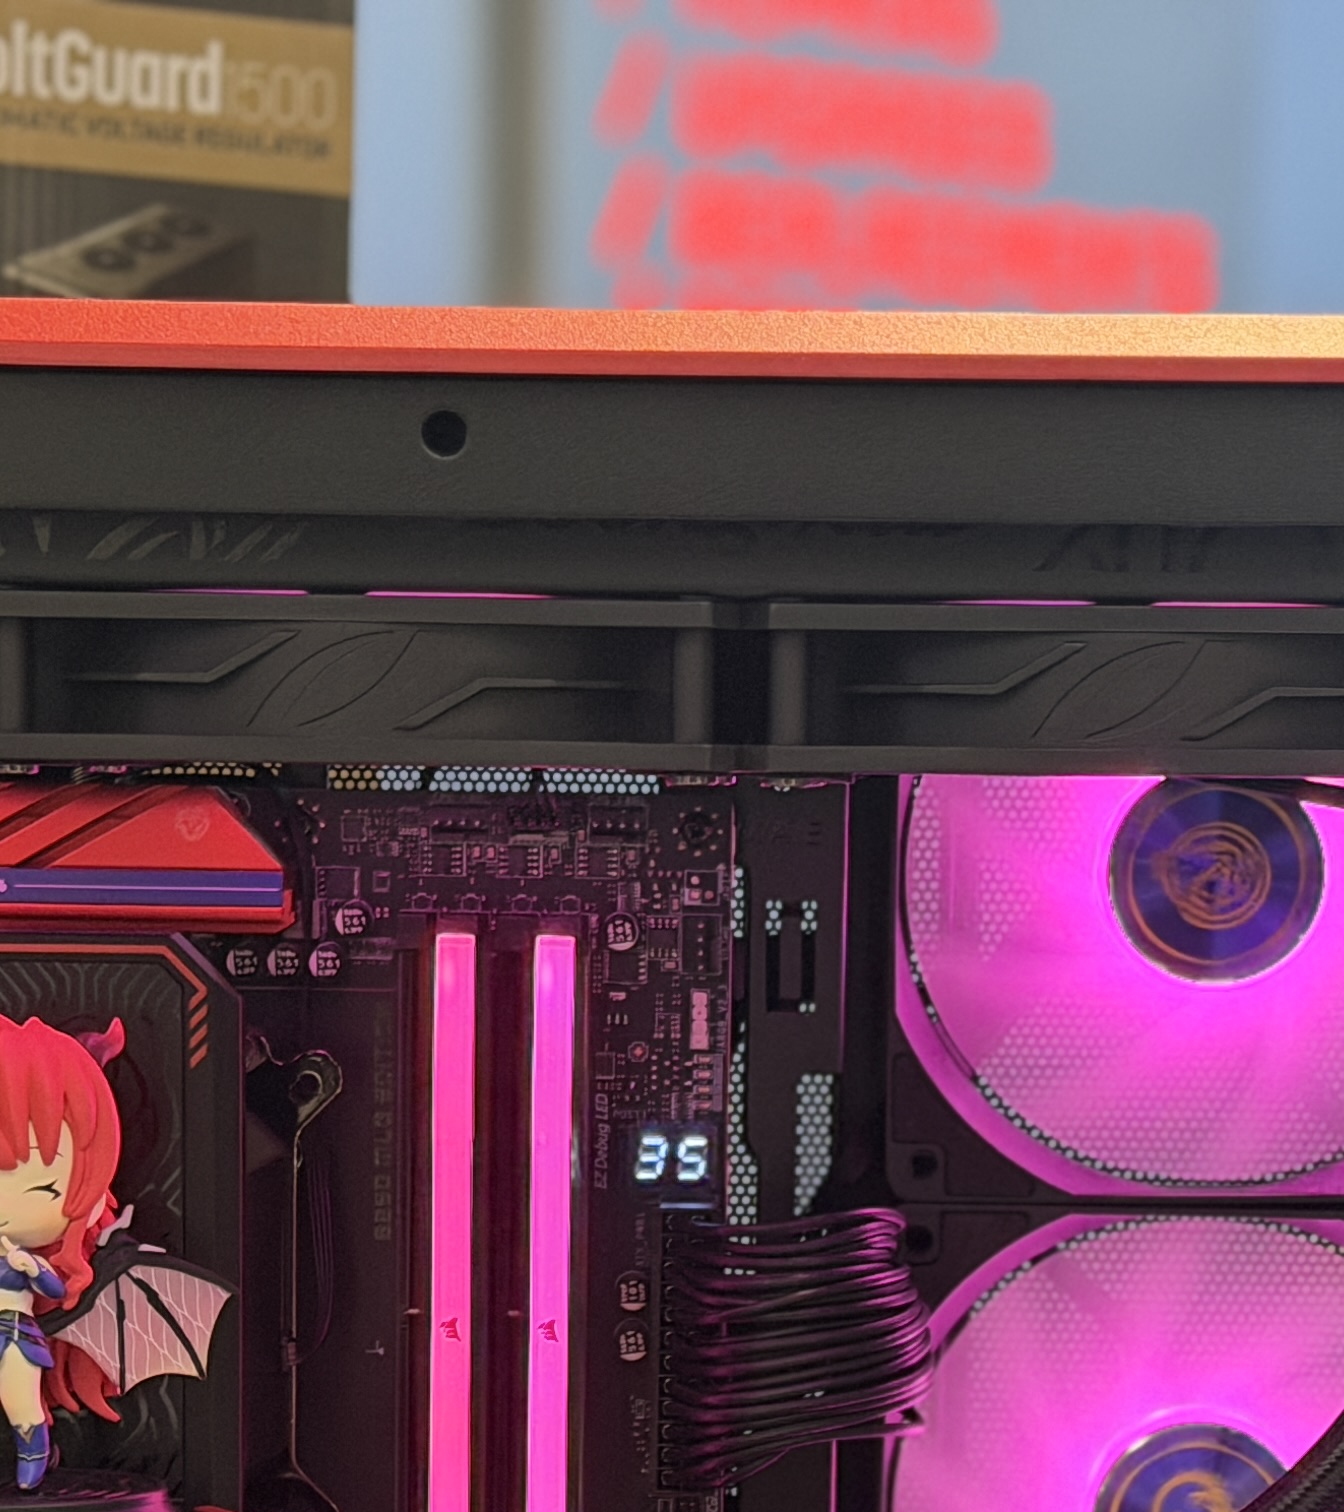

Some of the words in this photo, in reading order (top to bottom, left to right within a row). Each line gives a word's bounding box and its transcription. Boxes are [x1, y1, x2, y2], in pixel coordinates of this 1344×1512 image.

[595, 1093, 607, 1120] LED
[594, 1123, 611, 1169] Debug
[635, 1134, 708, 1183] 35
[594, 1172, 607, 1189] EZ
